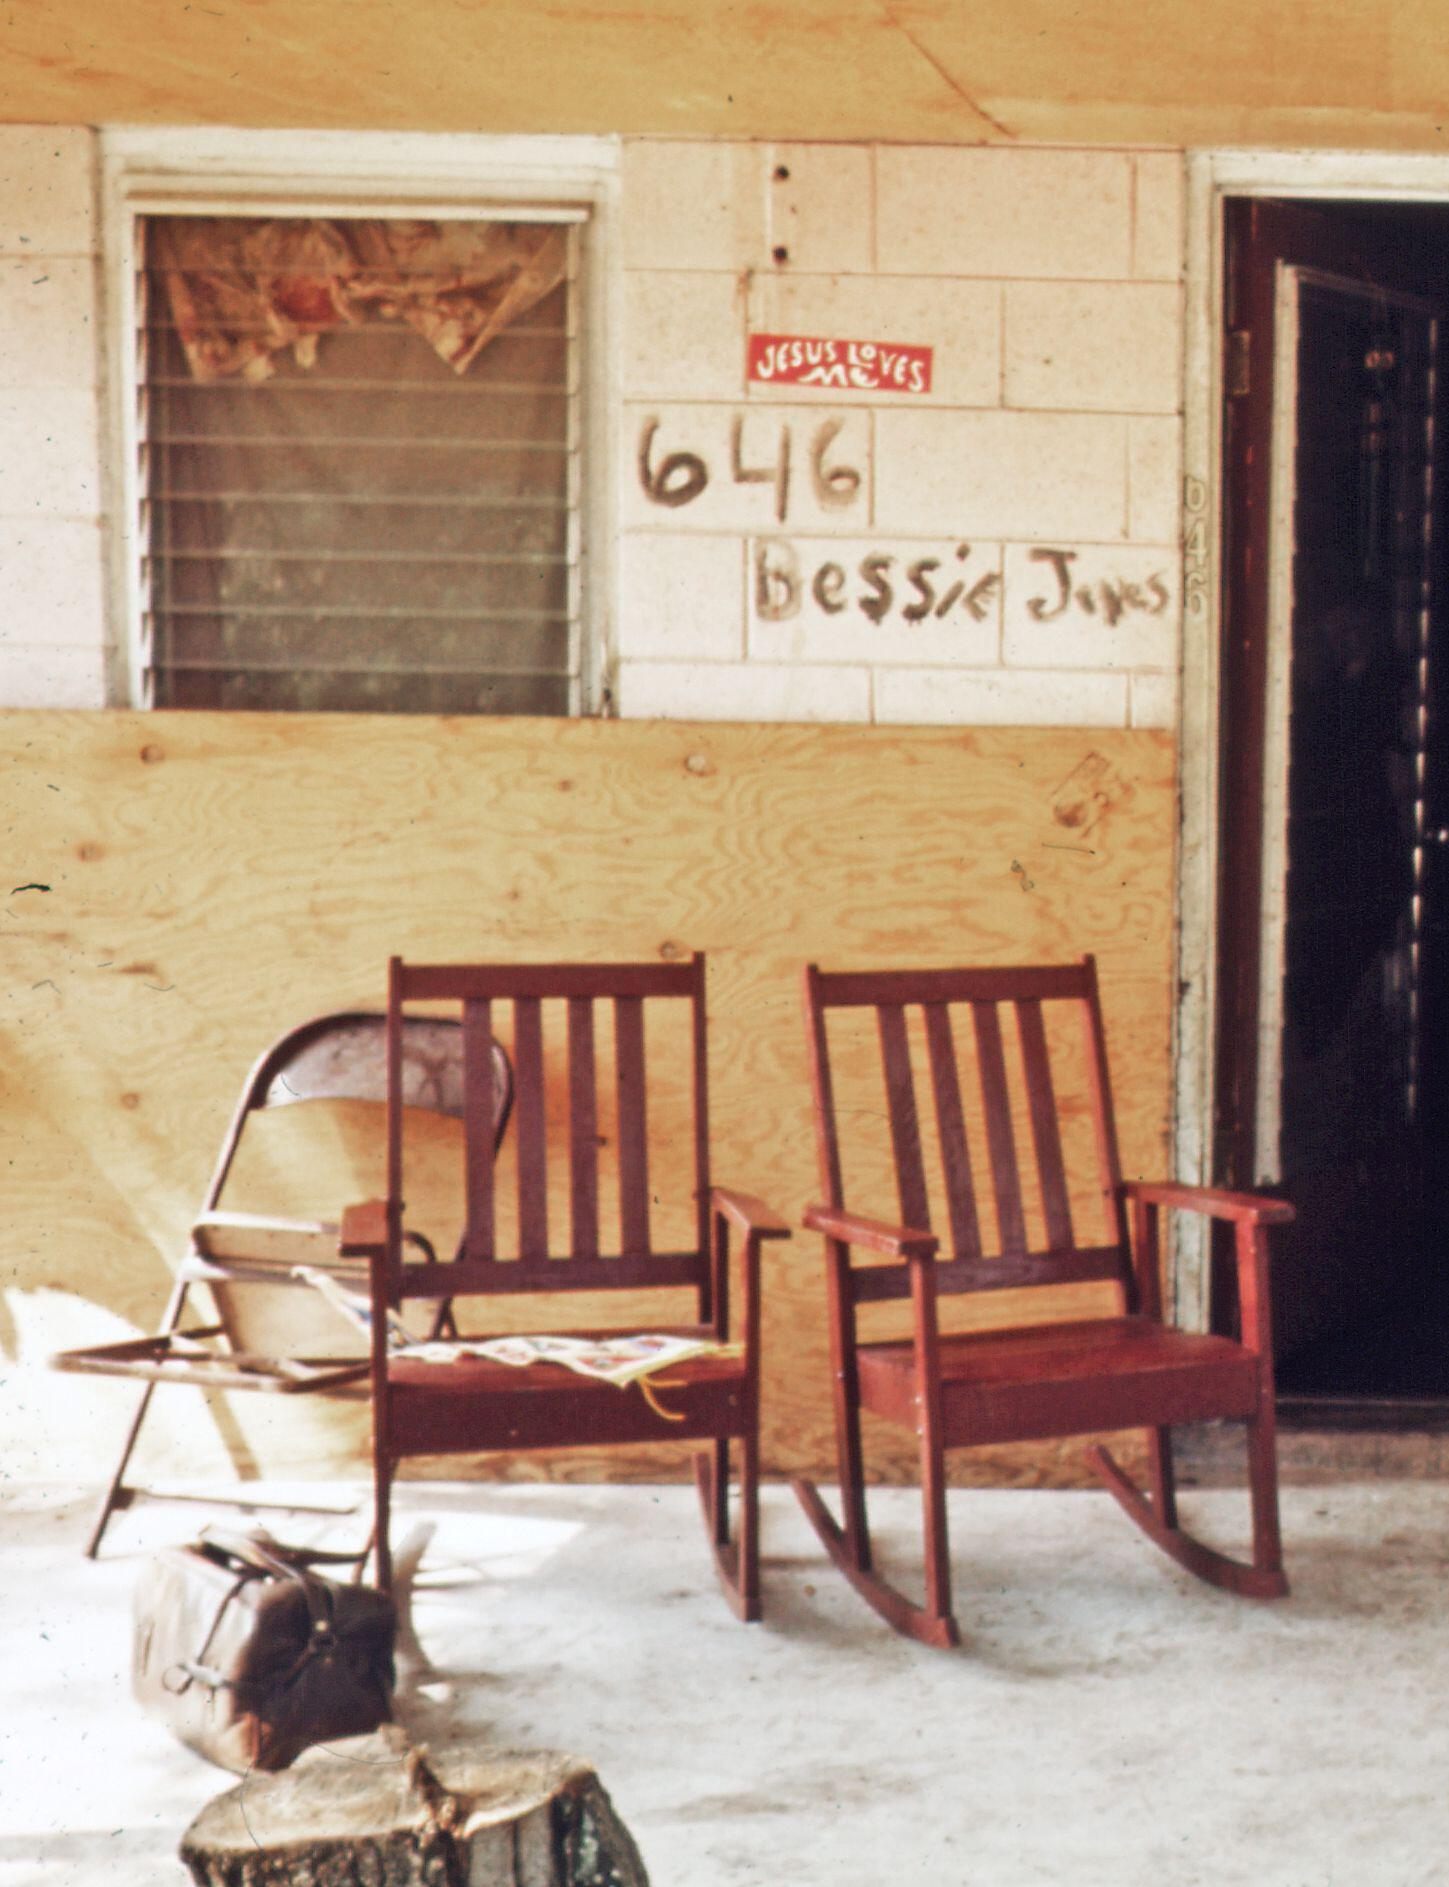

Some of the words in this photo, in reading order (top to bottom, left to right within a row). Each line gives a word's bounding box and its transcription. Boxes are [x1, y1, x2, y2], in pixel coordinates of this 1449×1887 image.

[756, 341, 836, 378] JESUS
[848, 343, 924, 392] LOVES
[638, 412, 861, 522] 646
